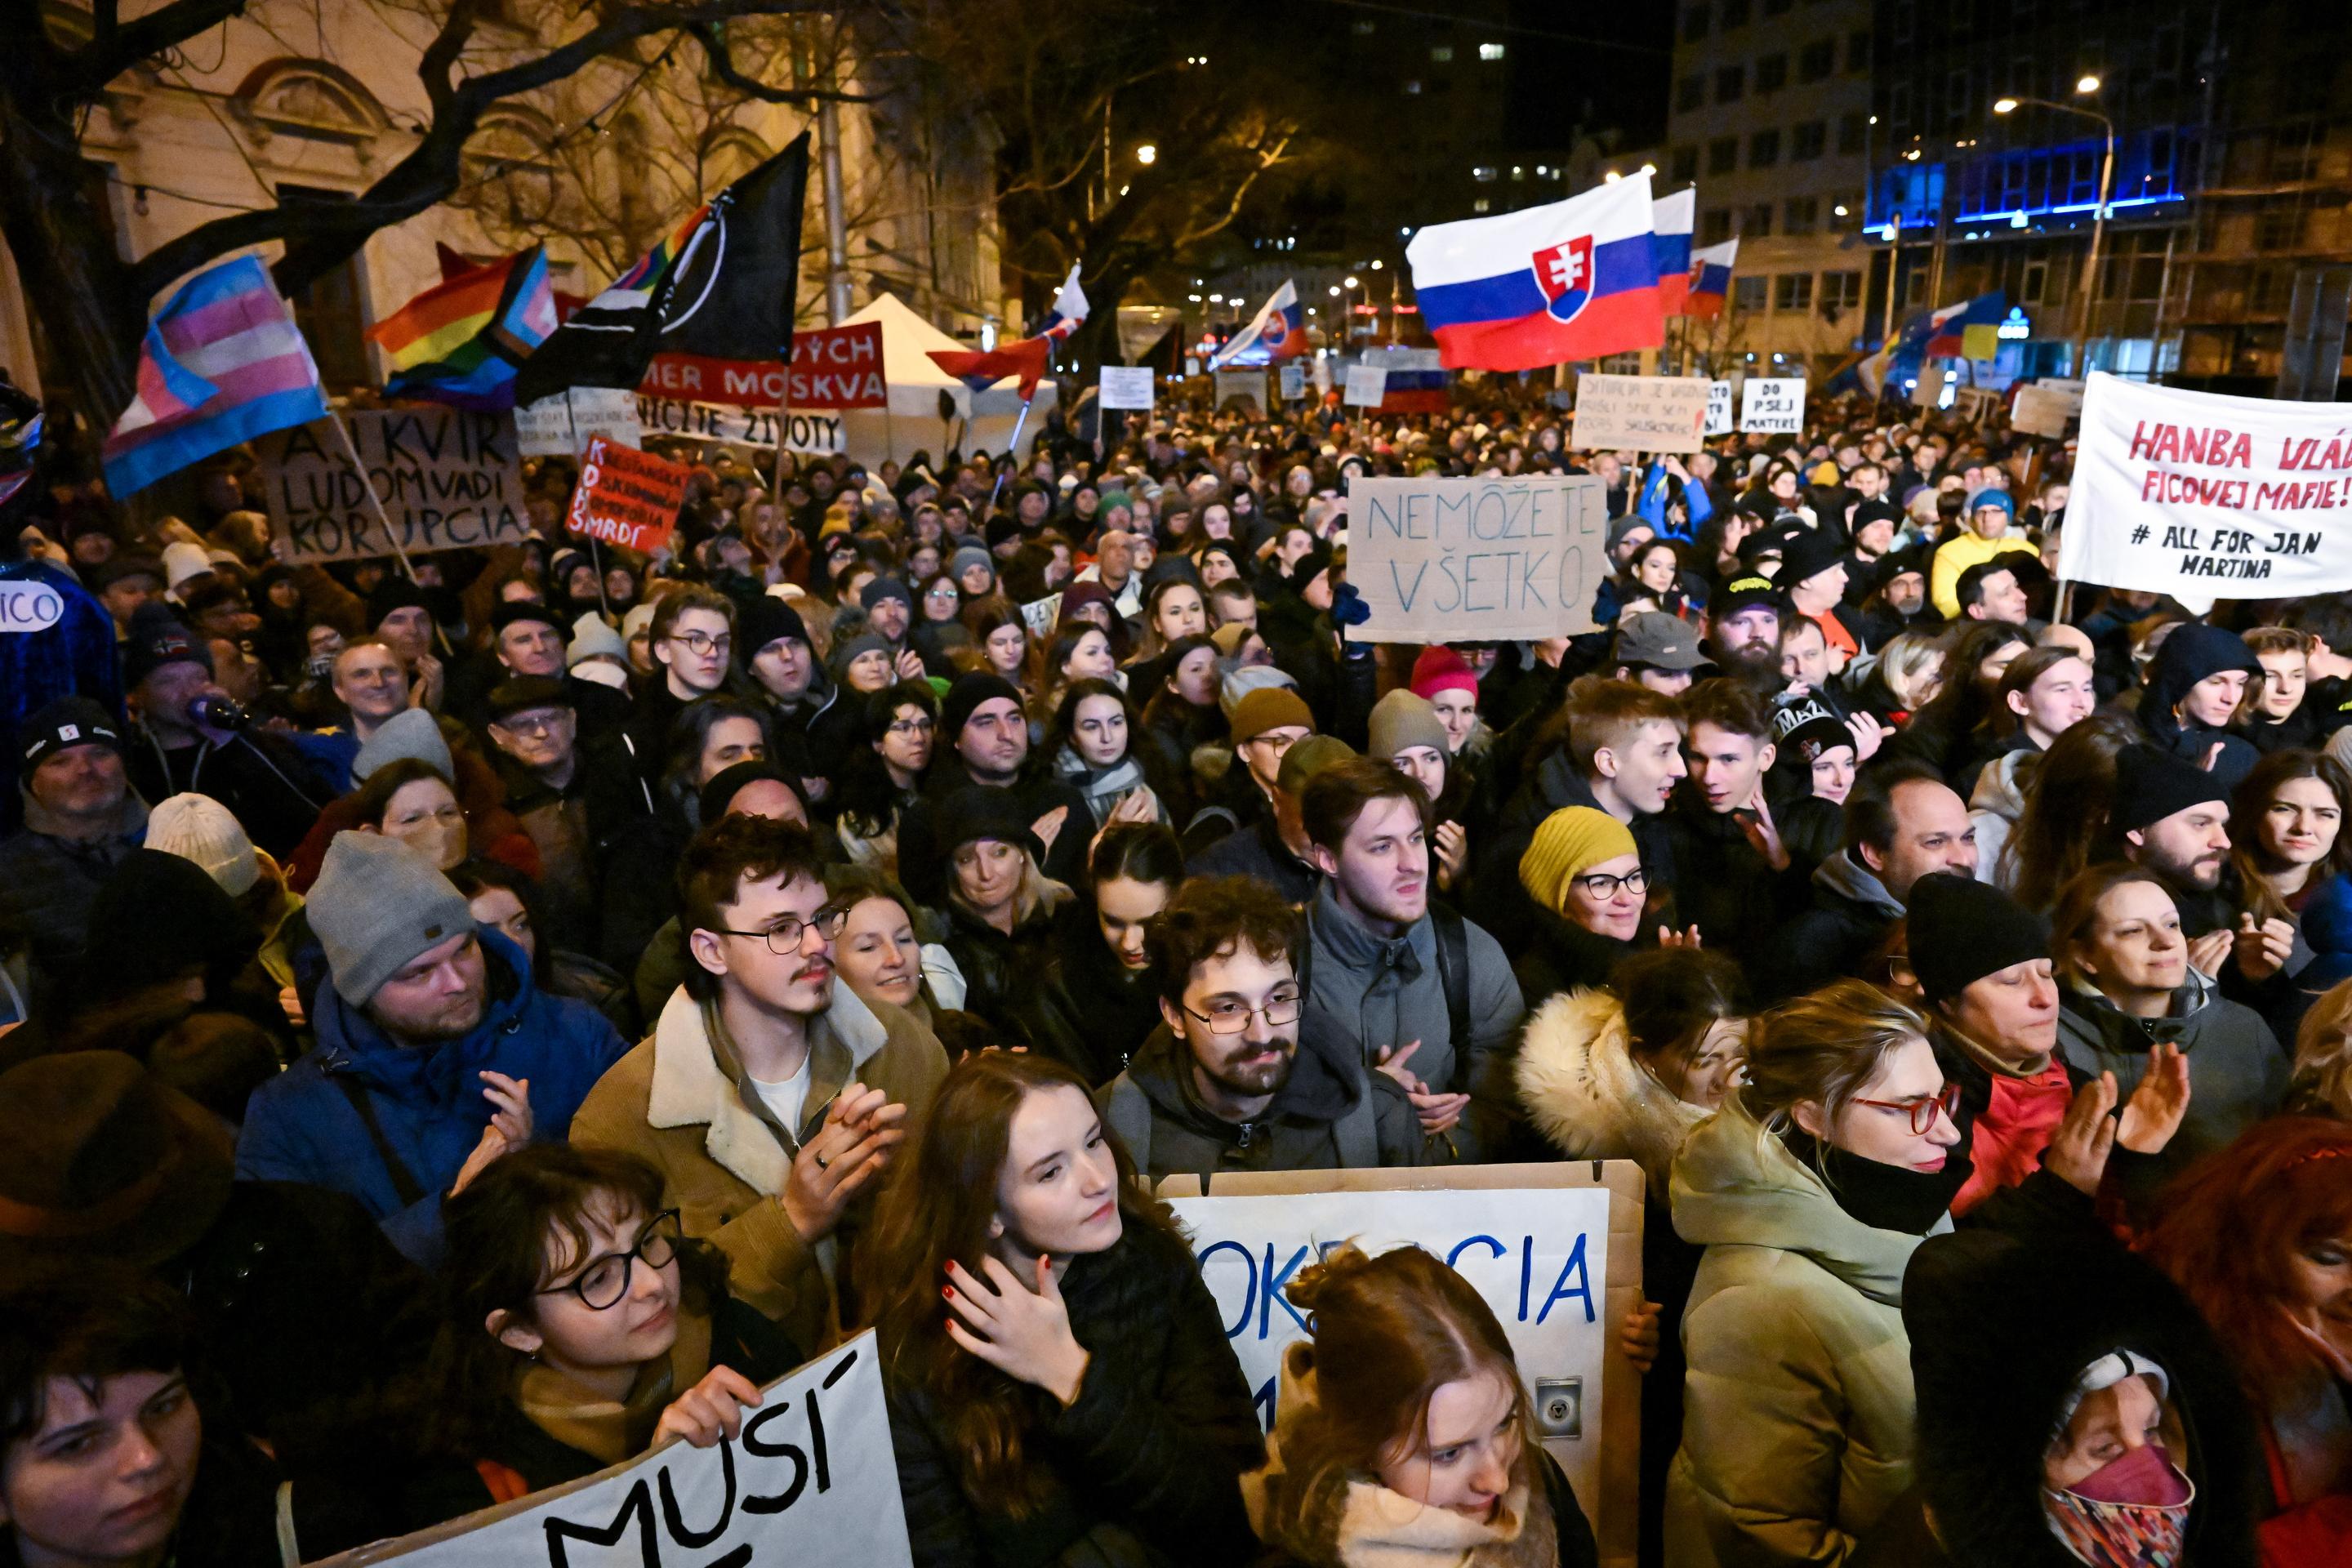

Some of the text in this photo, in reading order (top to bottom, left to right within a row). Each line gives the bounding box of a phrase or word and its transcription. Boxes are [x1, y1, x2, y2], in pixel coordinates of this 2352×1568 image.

[724, 367, 884, 401] MOSKVA
[1762, 384, 1780, 396] DO
[1754, 398, 1793, 412] PSEJ
[2129, 421, 2251, 469] HANBA
[2141, 470, 2248, 510] FICOVEJ
[287, 504, 523, 555] KORUPCIA
[1369, 483, 1597, 540] NEMÔŽETE
[2162, 526, 2199, 550] ALL
[2210, 529, 2255, 554] FOR
[2265, 532, 2322, 555] JAN
[1390, 546, 1584, 612] VŠETKO
[2180, 555, 2272, 578] MARTINA
[542, 1350, 858, 1568] MUSÍ
